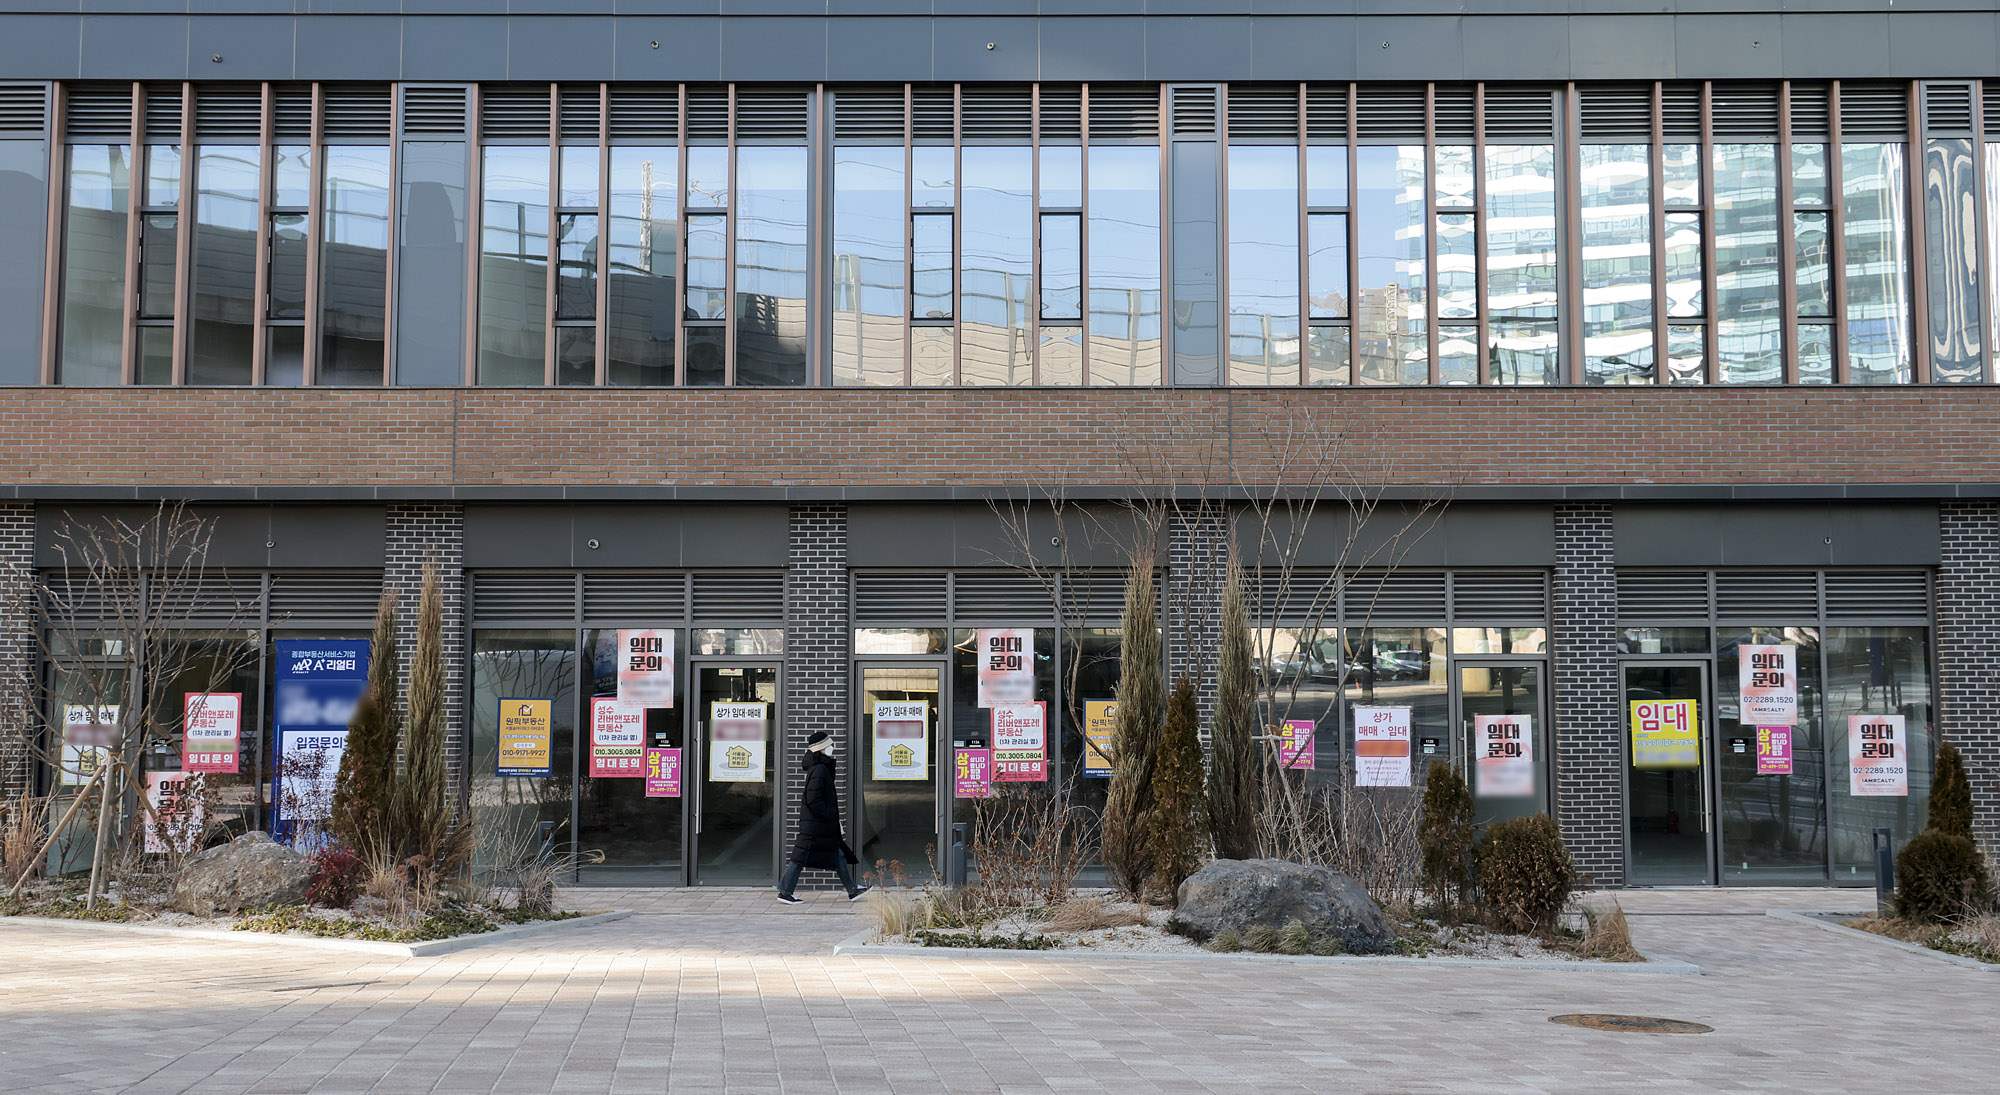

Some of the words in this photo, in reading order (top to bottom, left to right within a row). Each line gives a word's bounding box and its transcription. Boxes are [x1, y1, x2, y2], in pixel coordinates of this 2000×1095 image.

[629, 637, 663, 653] 임대
[989, 637, 1022, 652] 임대
[326, 659, 356, 671] 리얼티
[629, 656, 663, 671] 문의
[989, 655, 1022, 671] 문의
[1751, 653, 1784, 669] 임대
[1751, 672, 1785, 688] 문의
[1743, 696, 1794, 704] 02.2289.1520
[597, 706, 614, 714] 성수
[716, 707, 731, 718] 상가
[878, 706, 891, 717] 상가
[997, 710, 1014, 718] 성수
[506, 717, 545, 726] 원픽부동산
[597, 715, 640, 723] 리버앤포레
[997, 719, 1040, 727] 리버앤포레
[1373, 712, 1392, 722] 상가
[1637, 703, 1688, 731] 임대
[597, 724, 623, 732] 부동산
[997, 728, 1023, 736] 부동산
[1358, 726, 1378, 737] 매매
[1387, 726, 1407, 737] 임대
[1487, 724, 1520, 739] 임대
[1860, 724, 1894, 739] 임대
[296, 736, 343, 750] 입점문의
[1758, 728, 1771, 755] 상가
[1487, 742, 1520, 758] 문의
[1861, 743, 1894, 758] 문의
[188, 753, 233, 764] 임대문의
[596, 758, 640, 768] 임대문의
[648, 752, 661, 778] 상가
[957, 752, 970, 779] 상가
[997, 762, 1041, 772] 임대문의
